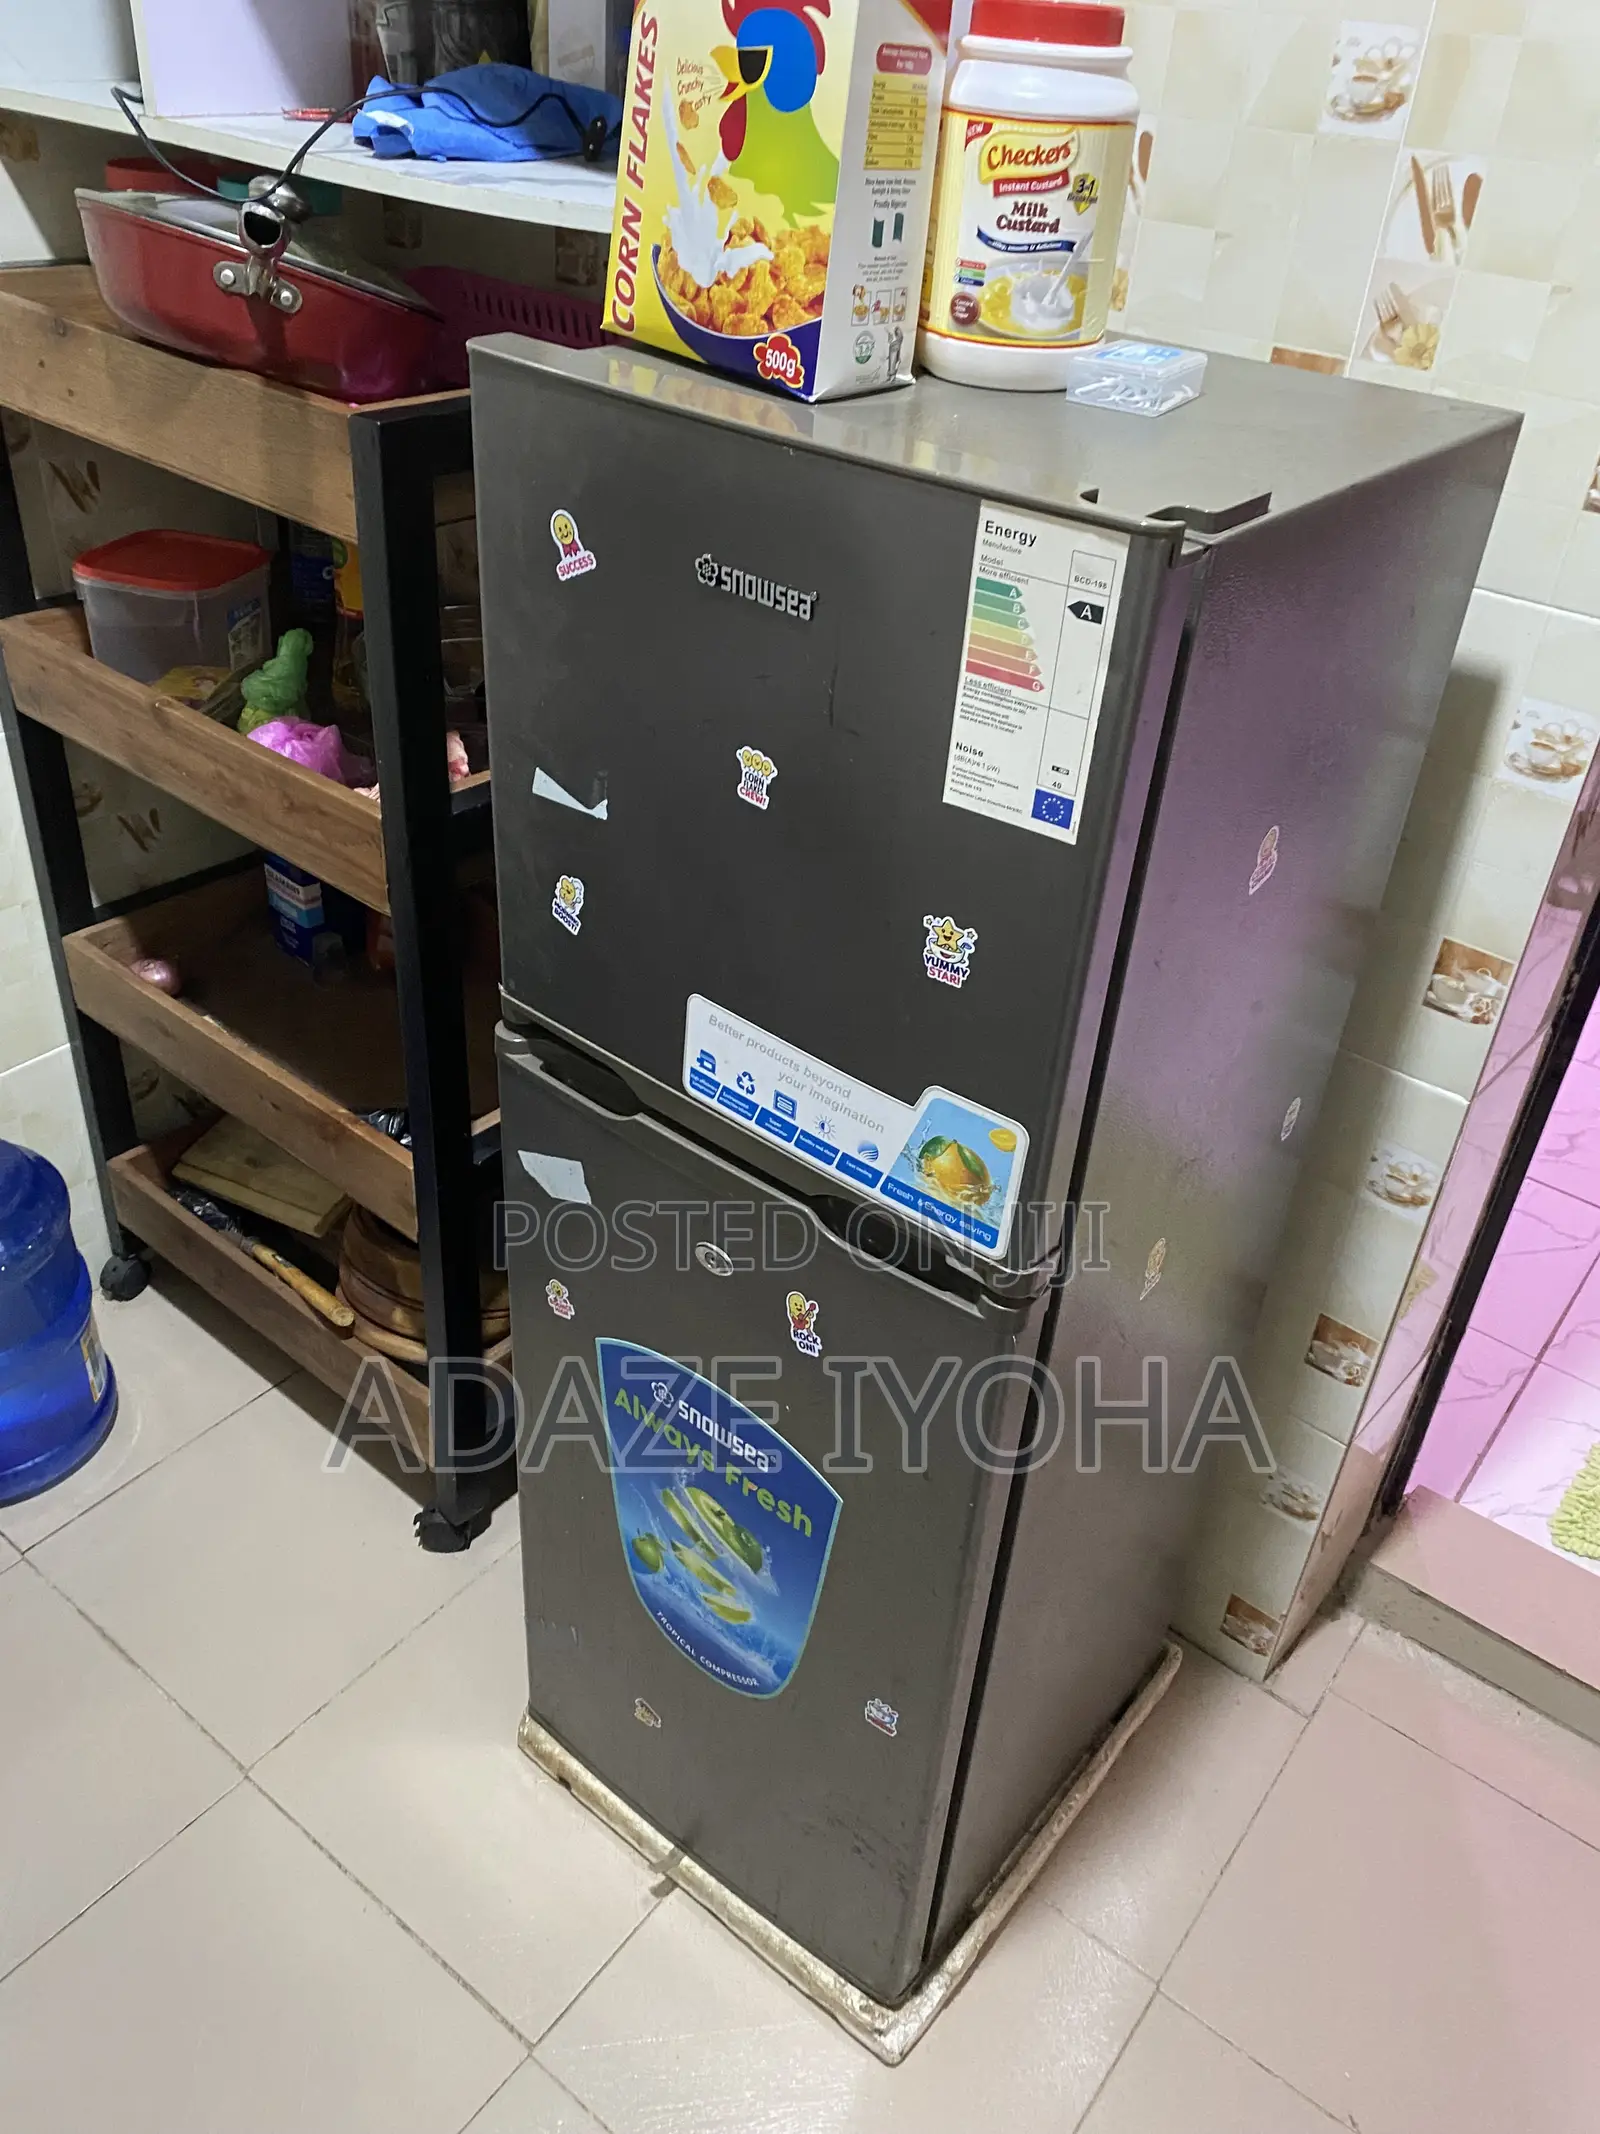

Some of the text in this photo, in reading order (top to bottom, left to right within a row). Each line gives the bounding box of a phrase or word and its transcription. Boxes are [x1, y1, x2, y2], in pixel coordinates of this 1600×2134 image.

[987, 141, 1071, 171] Checkers
[610, 11, 659, 333] CORN FLAKES
[999, 175, 1063, 193] Instant Custard
[1010, 201, 1049, 218] Milk
[996, 214, 1061, 234] Custard
[764, 346, 797, 379] 500g
[984, 519, 1037, 548] Energy
[982, 538, 1022, 556] Manufacture
[557, 553, 594, 577] SUCCESS
[980, 554, 1004, 566] Model
[979, 566, 1029, 586] More efficient
[1009, 588, 1018, 599] A
[1012, 603, 1021, 614] B
[1080, 604, 1093, 620] A
[1017, 619, 1025, 630] C
[1021, 634, 1029, 645] D
[1025, 650, 1032, 661] E
[1029, 665, 1036, 676] F
[965, 676, 1012, 697] Less efficient
[1032, 681, 1041, 691] G
[956, 742, 984, 757] Noise
[744, 771, 765, 788] CORN
[740, 786, 767, 806] CREW!
[554, 908, 577, 931] BOOST!
[925, 954, 968, 978] YUMMY
[929, 967, 960, 986] STAR!
[708, 1013, 852, 1100] Better products beyond
[776, 1070, 806, 1093] your
[808, 1084, 885, 1135] imagination
[887, 1182, 914, 1202] Fresh
[959, 1220, 992, 1242] saving
[794, 1330, 819, 1345] ROCK
[799, 1341, 816, 1354] ON!
[614, 1386, 812, 1538] Always Fresh
[655, 1610, 760, 1687] TROPICAL COMPRESSOR
